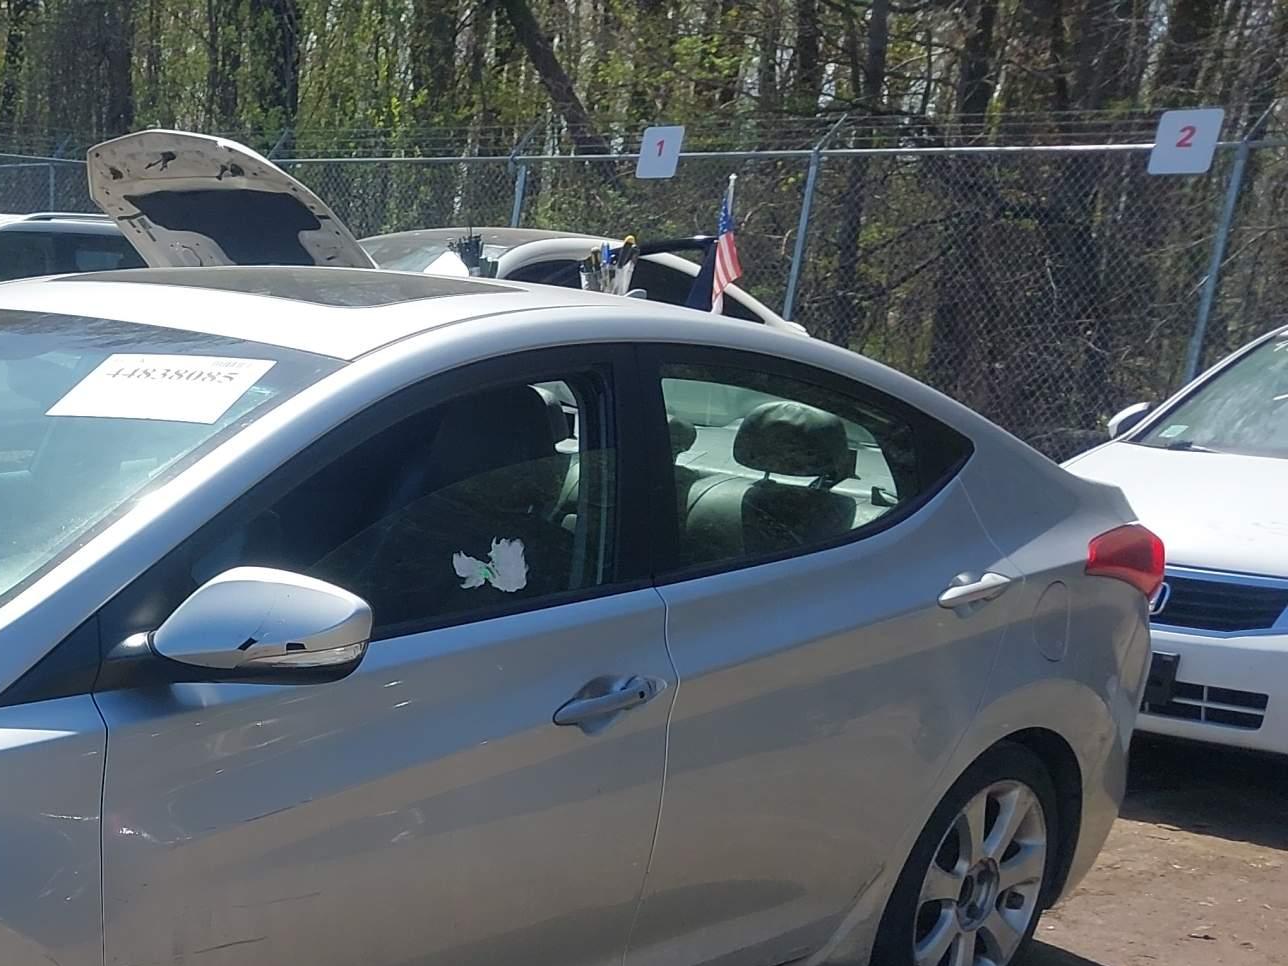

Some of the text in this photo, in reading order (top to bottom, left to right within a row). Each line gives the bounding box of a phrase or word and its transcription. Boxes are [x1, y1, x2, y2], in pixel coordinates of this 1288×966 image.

[1175, 125, 1196, 148] 2
[656, 139, 665, 157] 1
[106, 367, 240, 384] 44838085
